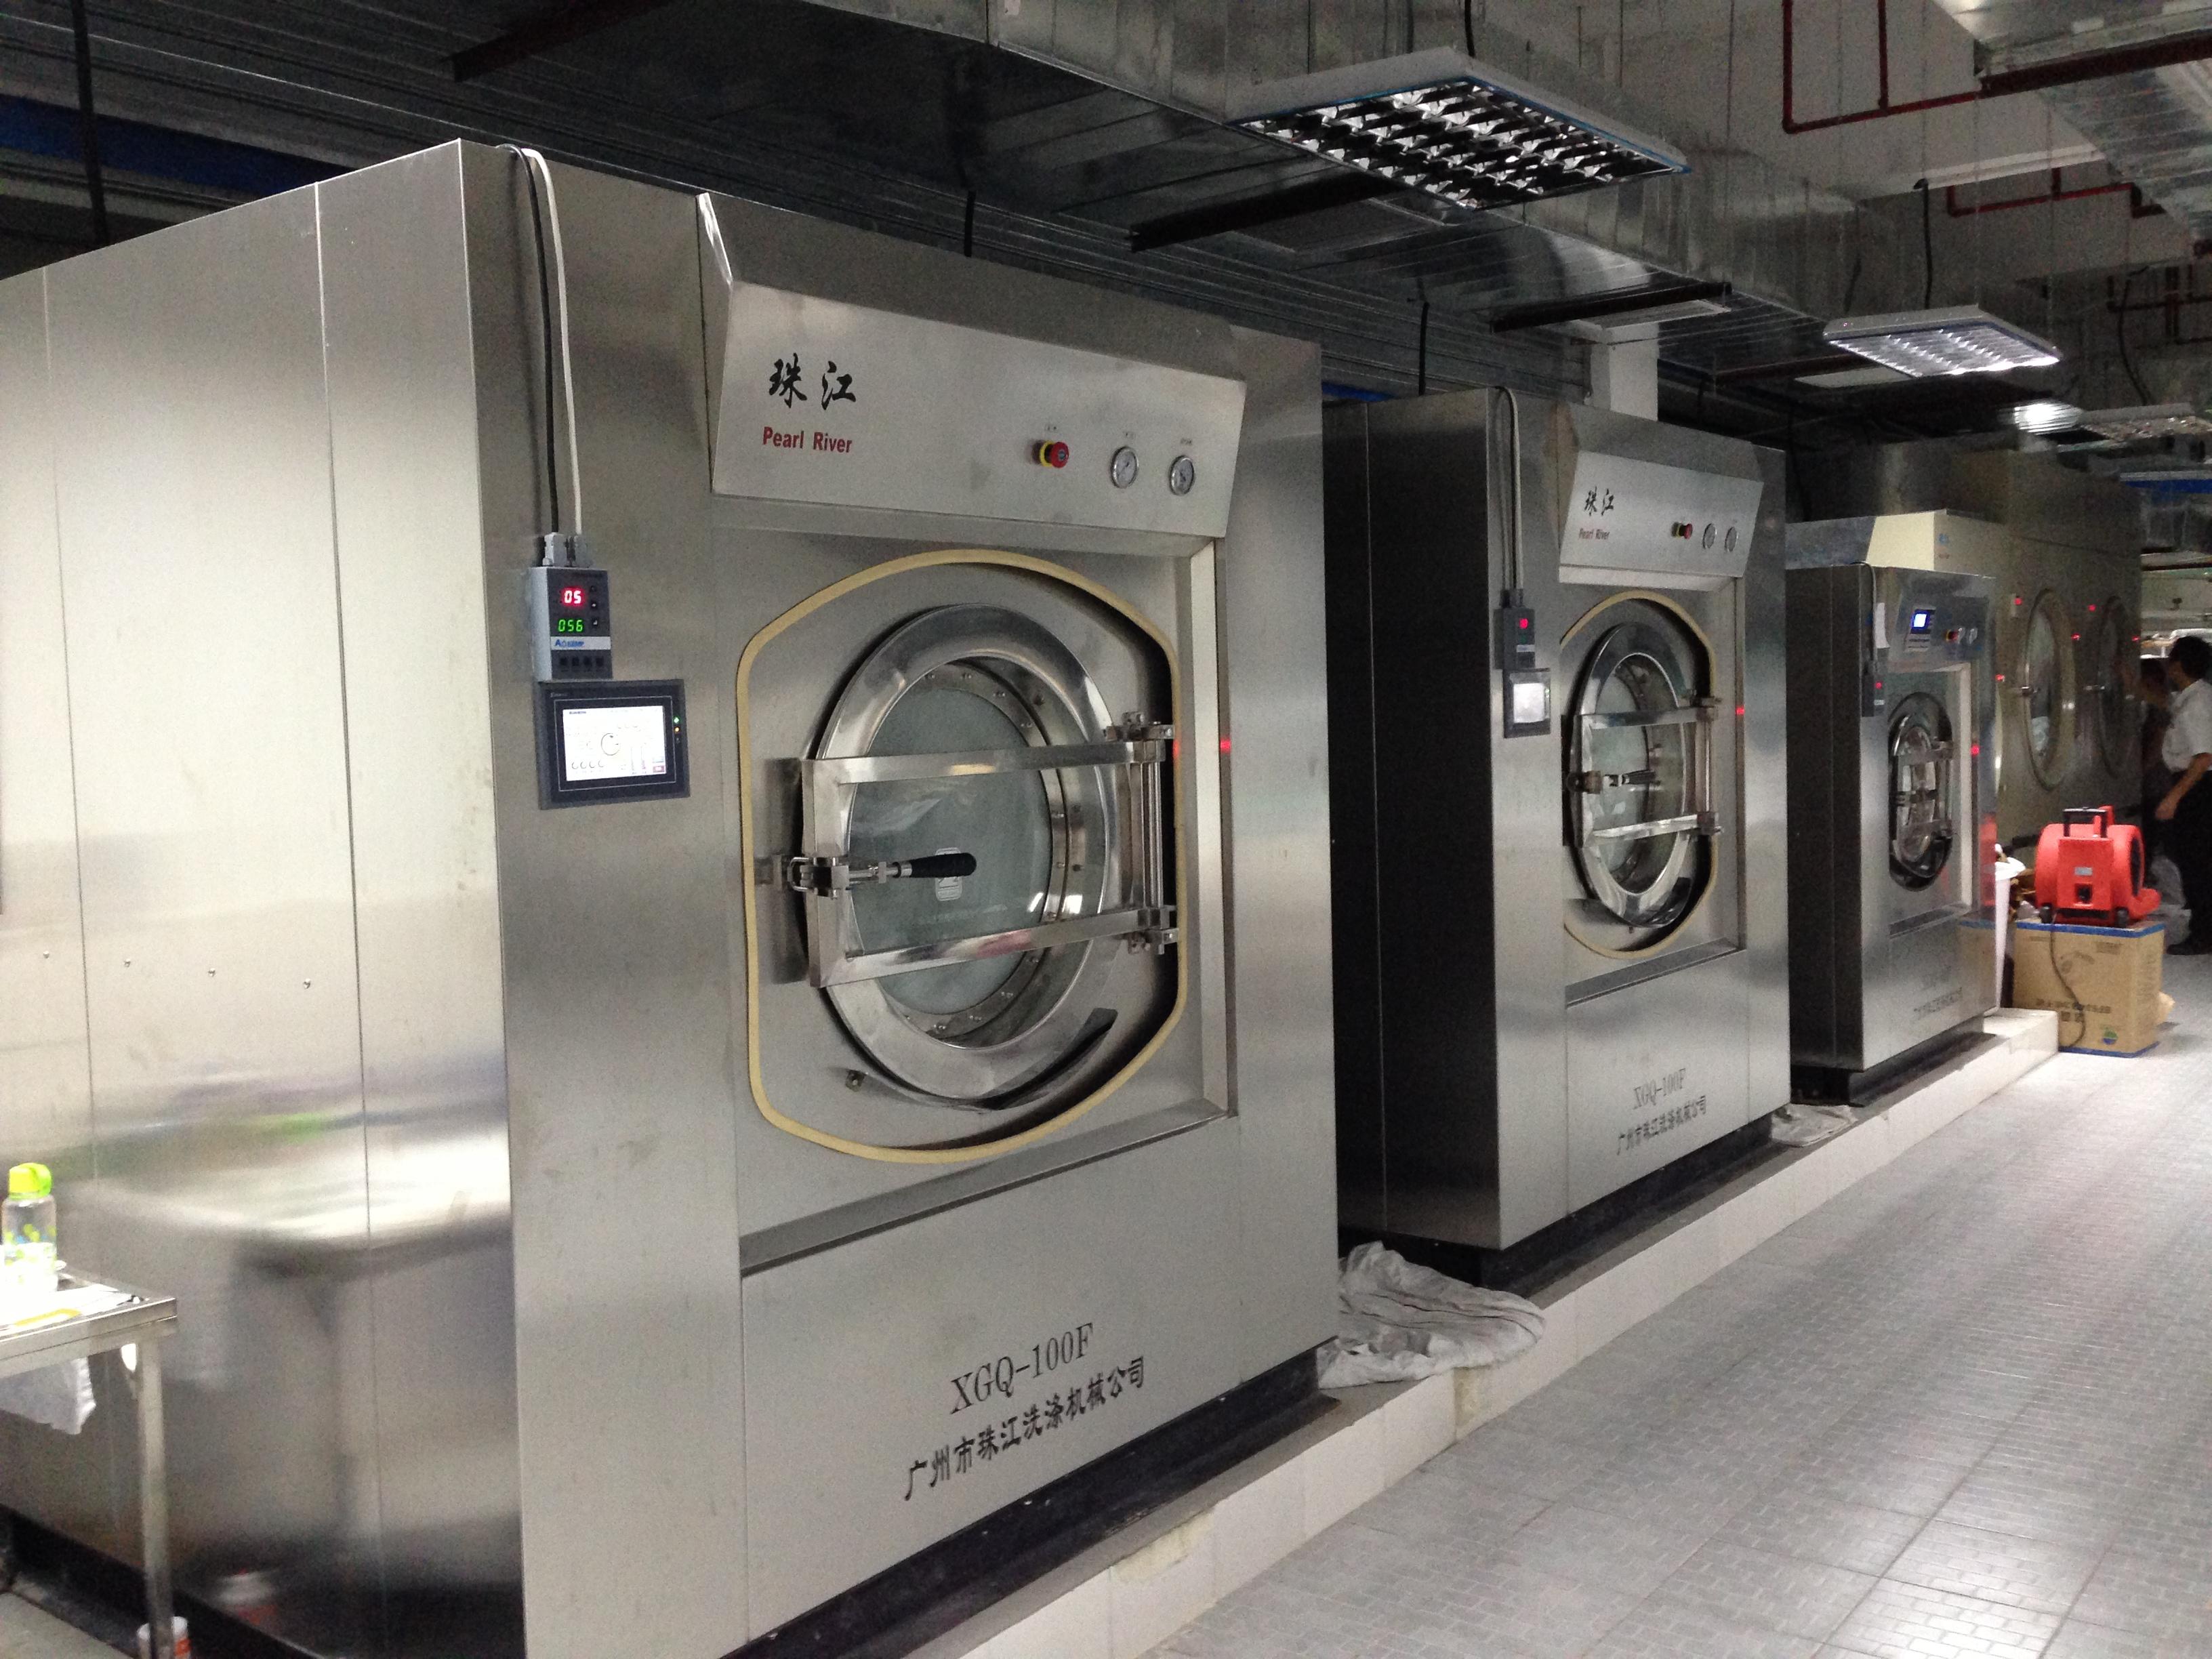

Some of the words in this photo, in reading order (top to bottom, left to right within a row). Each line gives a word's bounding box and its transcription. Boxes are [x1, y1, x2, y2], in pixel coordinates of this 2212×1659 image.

[769, 352, 857, 411] 珠江
[762, 426, 805, 449] Pearl
[813, 430, 853, 453] River
[1584, 485, 1614, 516] 珠江
[558, 619, 583, 632] 056
[950, 1322, 1094, 1414] XGQ-100F
[905, 1355, 1145, 1502] 广州市珠江洗涤机械公司
